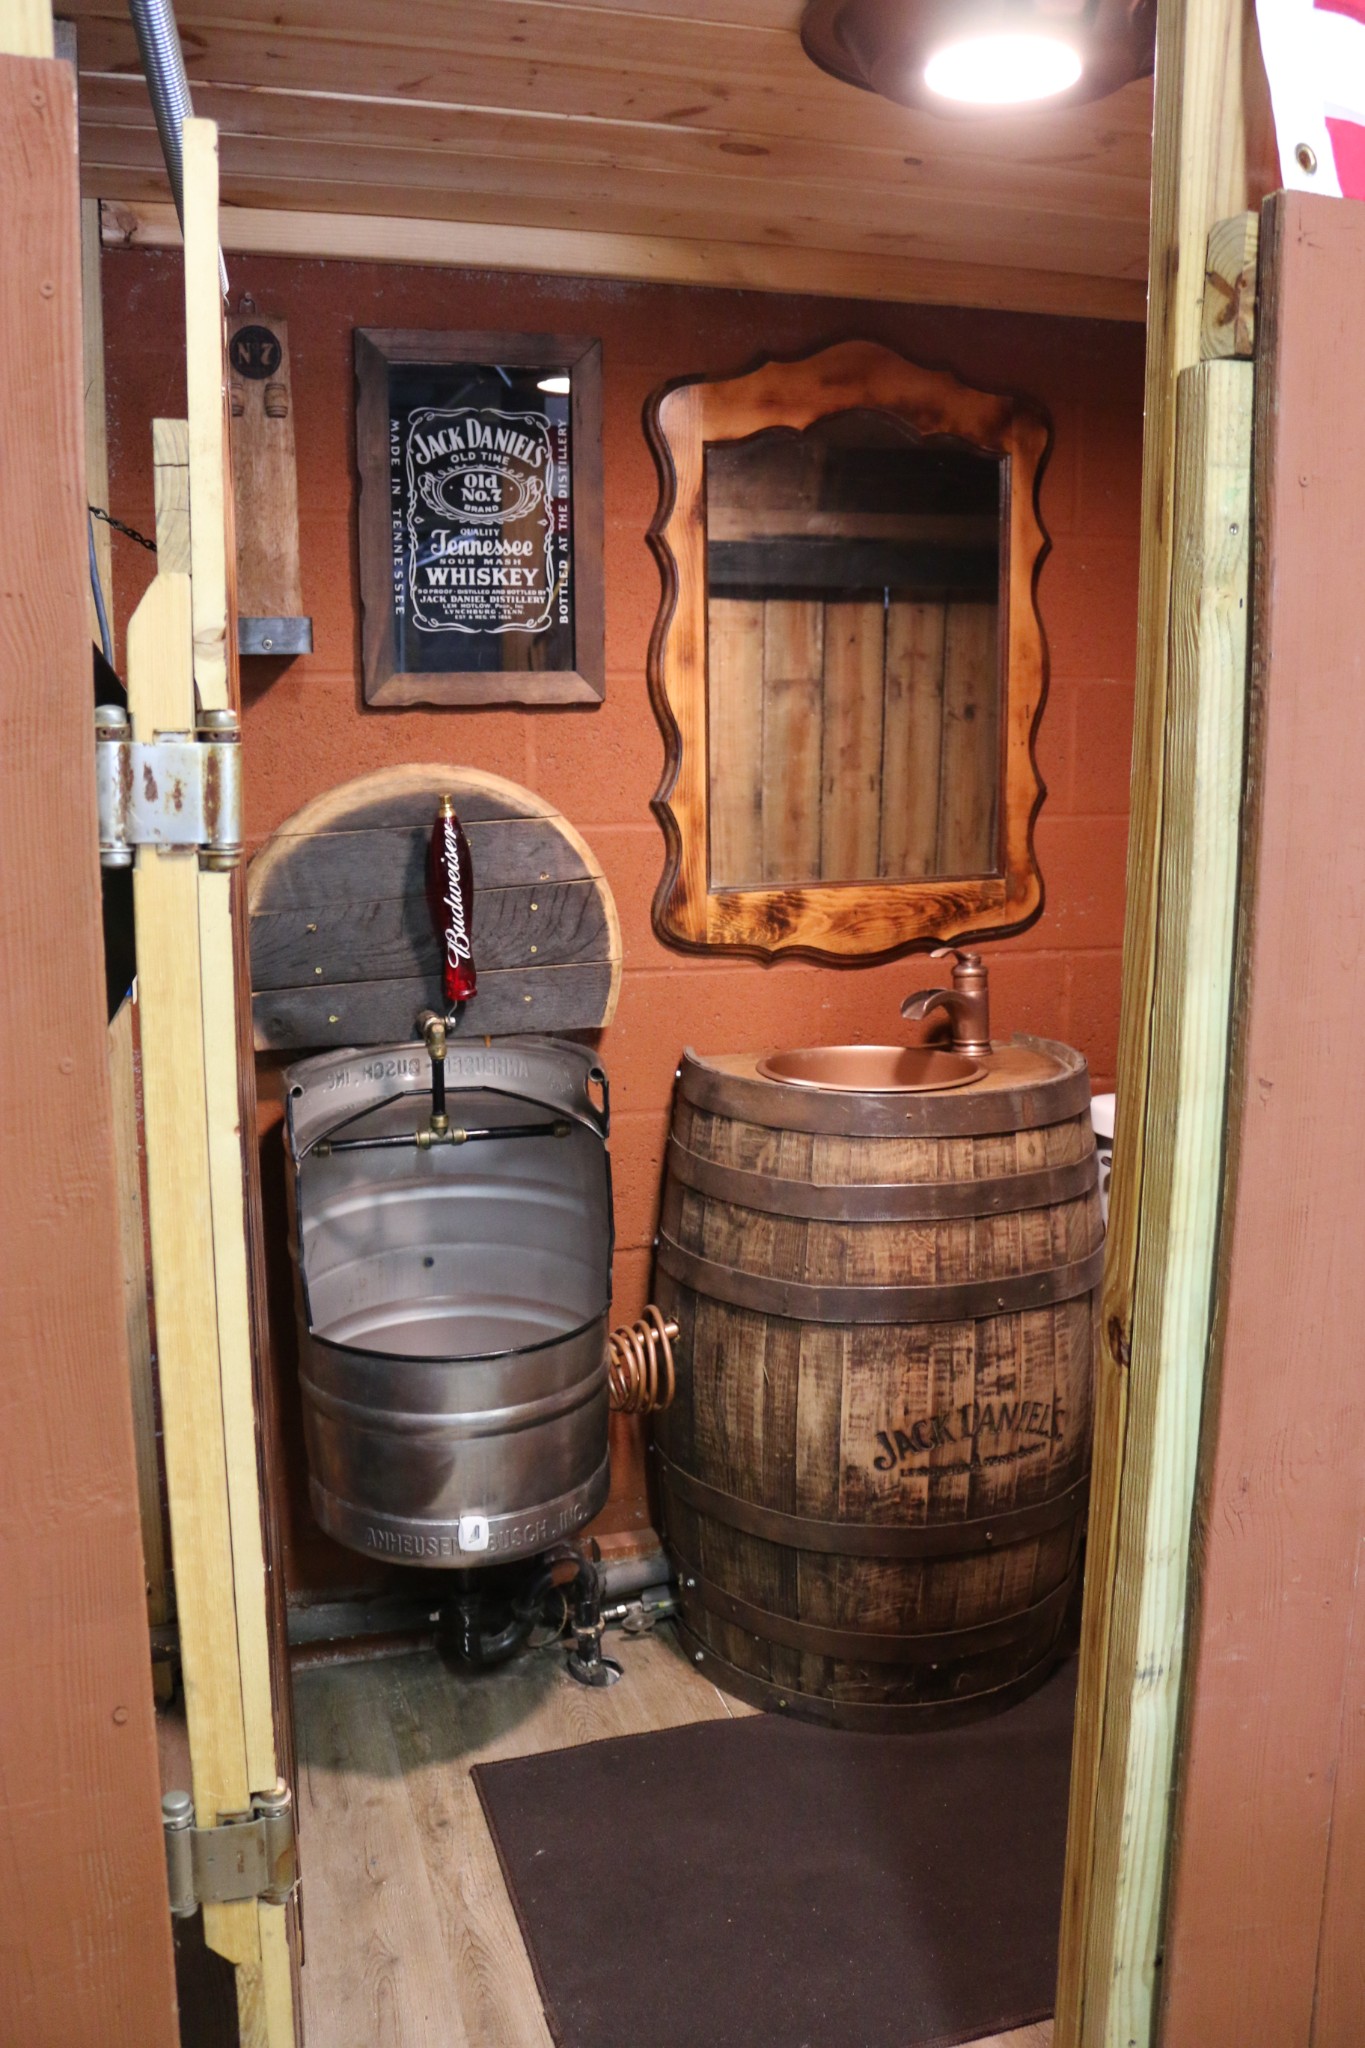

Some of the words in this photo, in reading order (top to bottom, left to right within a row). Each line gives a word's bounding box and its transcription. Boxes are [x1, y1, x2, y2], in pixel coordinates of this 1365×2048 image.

[390, 420, 400, 466] MADE
[414, 426, 466, 464] JACK
[466, 418, 547, 468] DANIEL'S
[450, 452, 476, 463] OLD
[481, 452, 510, 466] TIME
[557, 419, 568, 498] DISTILLERY
[391, 479, 401, 495] IN
[463, 473, 498, 488] Old
[464, 504, 499, 513] BRAND
[558, 504, 568, 530] THE
[430, 529, 533, 556] Tennessee
[460, 528, 500, 537] QUALITY
[558, 540, 568, 551] AT
[392, 508, 404, 615] TENNESSEE
[425, 567, 539, 586] WHISKEY
[420, 596, 447, 604] JACK
[451, 596, 486, 604] DANIEL
[489, 596, 546, 604] DISTILLERY
[559, 560, 568, 624] BOTTLED
[440, 818, 471, 969] Budweiser
[873, 1410, 956, 1471] JACK
